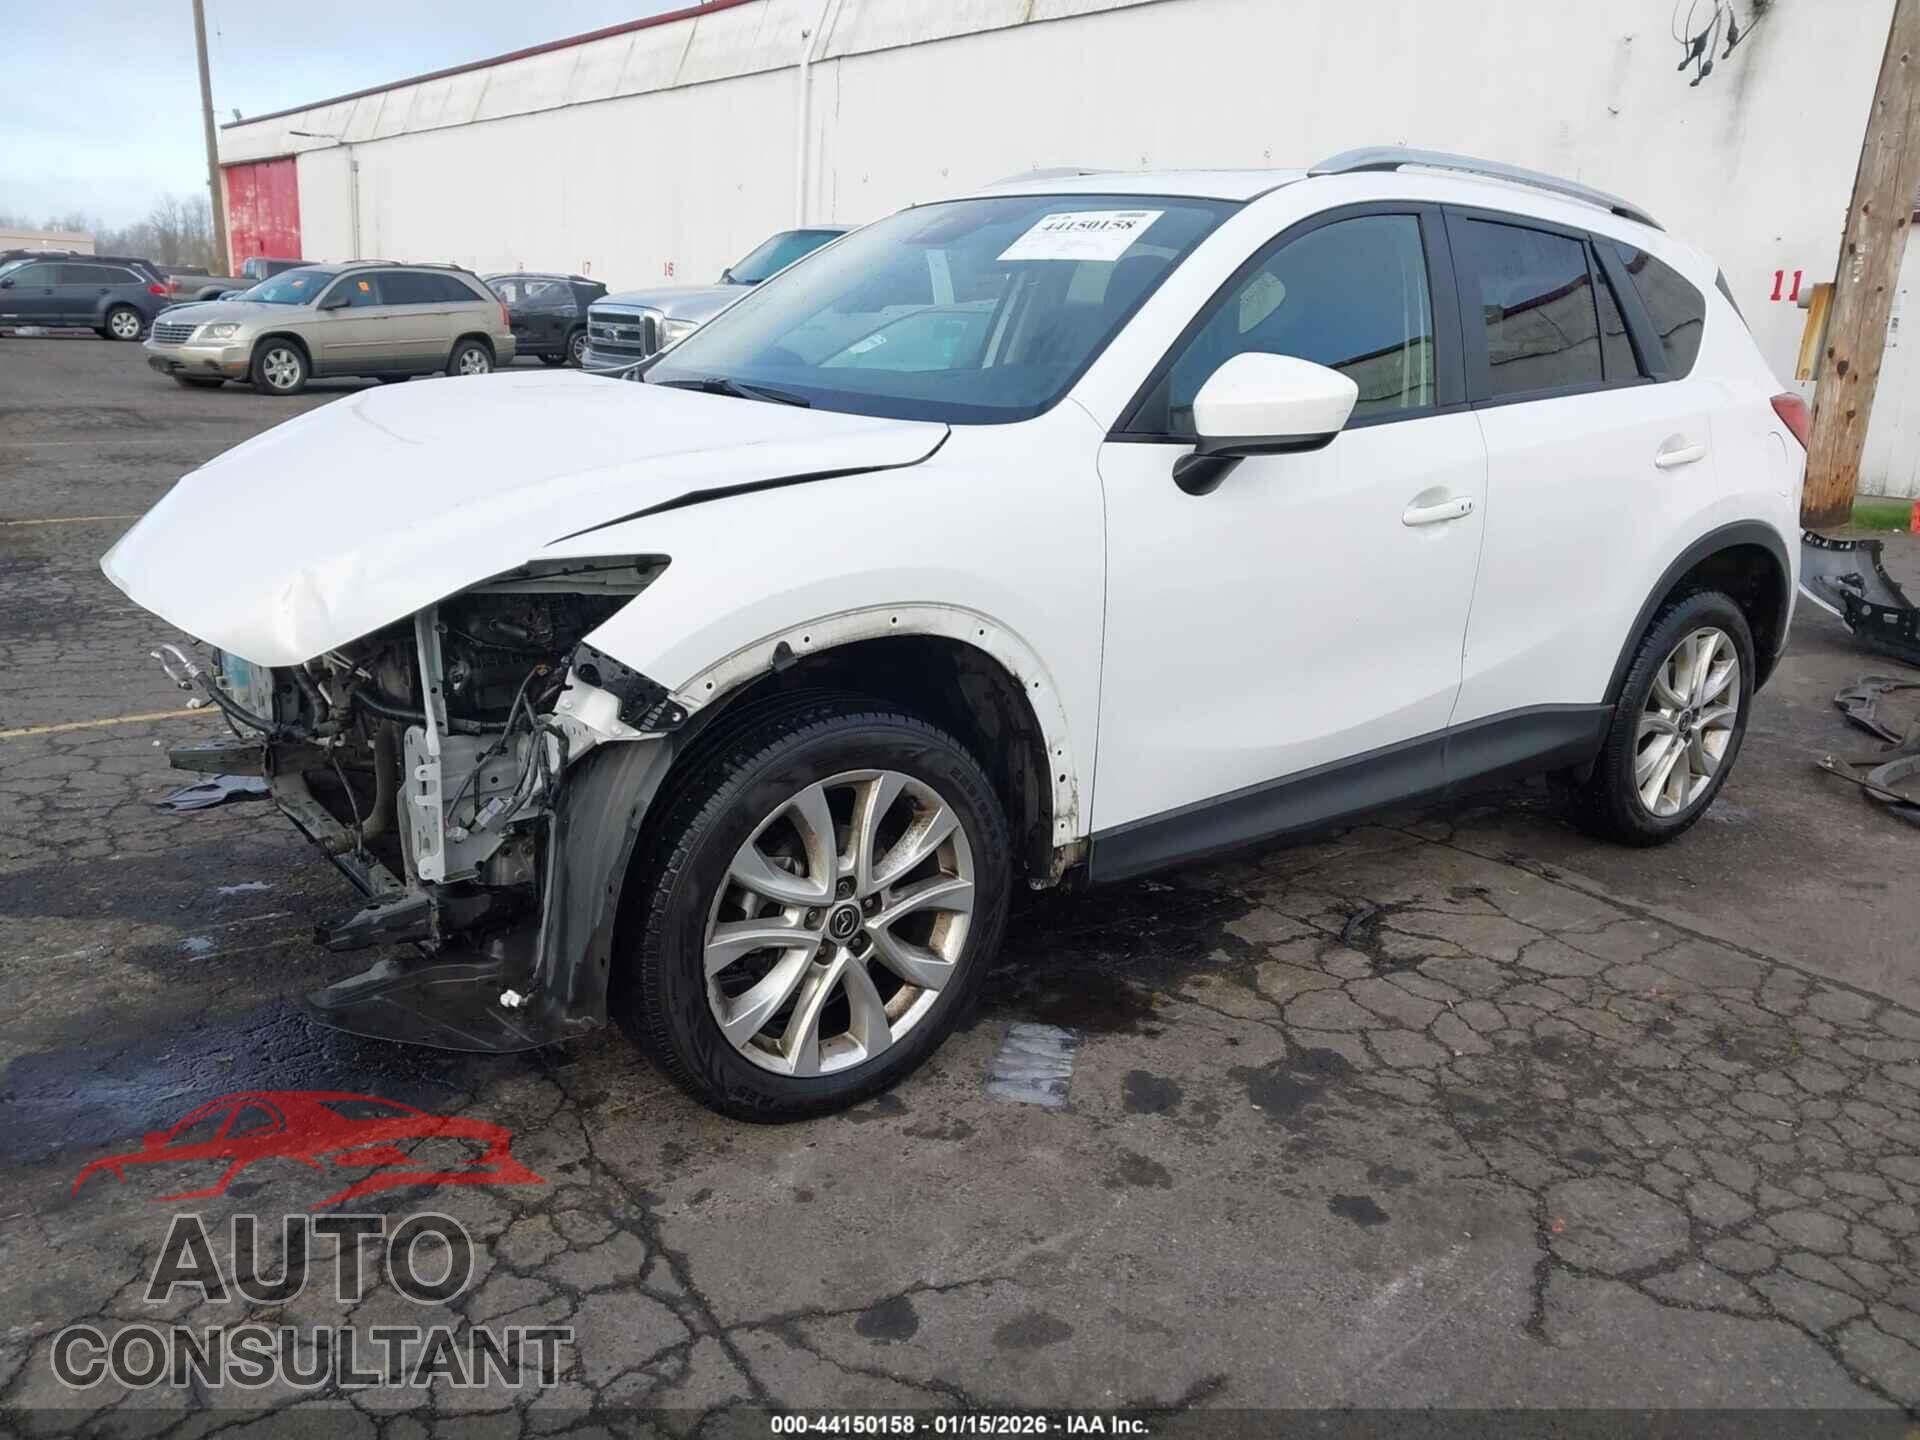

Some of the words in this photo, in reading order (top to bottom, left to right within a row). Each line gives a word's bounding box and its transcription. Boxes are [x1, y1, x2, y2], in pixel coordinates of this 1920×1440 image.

[1041, 219, 1137, 231] 44150158
[664, 261, 674, 277] 16
[1770, 270, 1803, 301] 11
